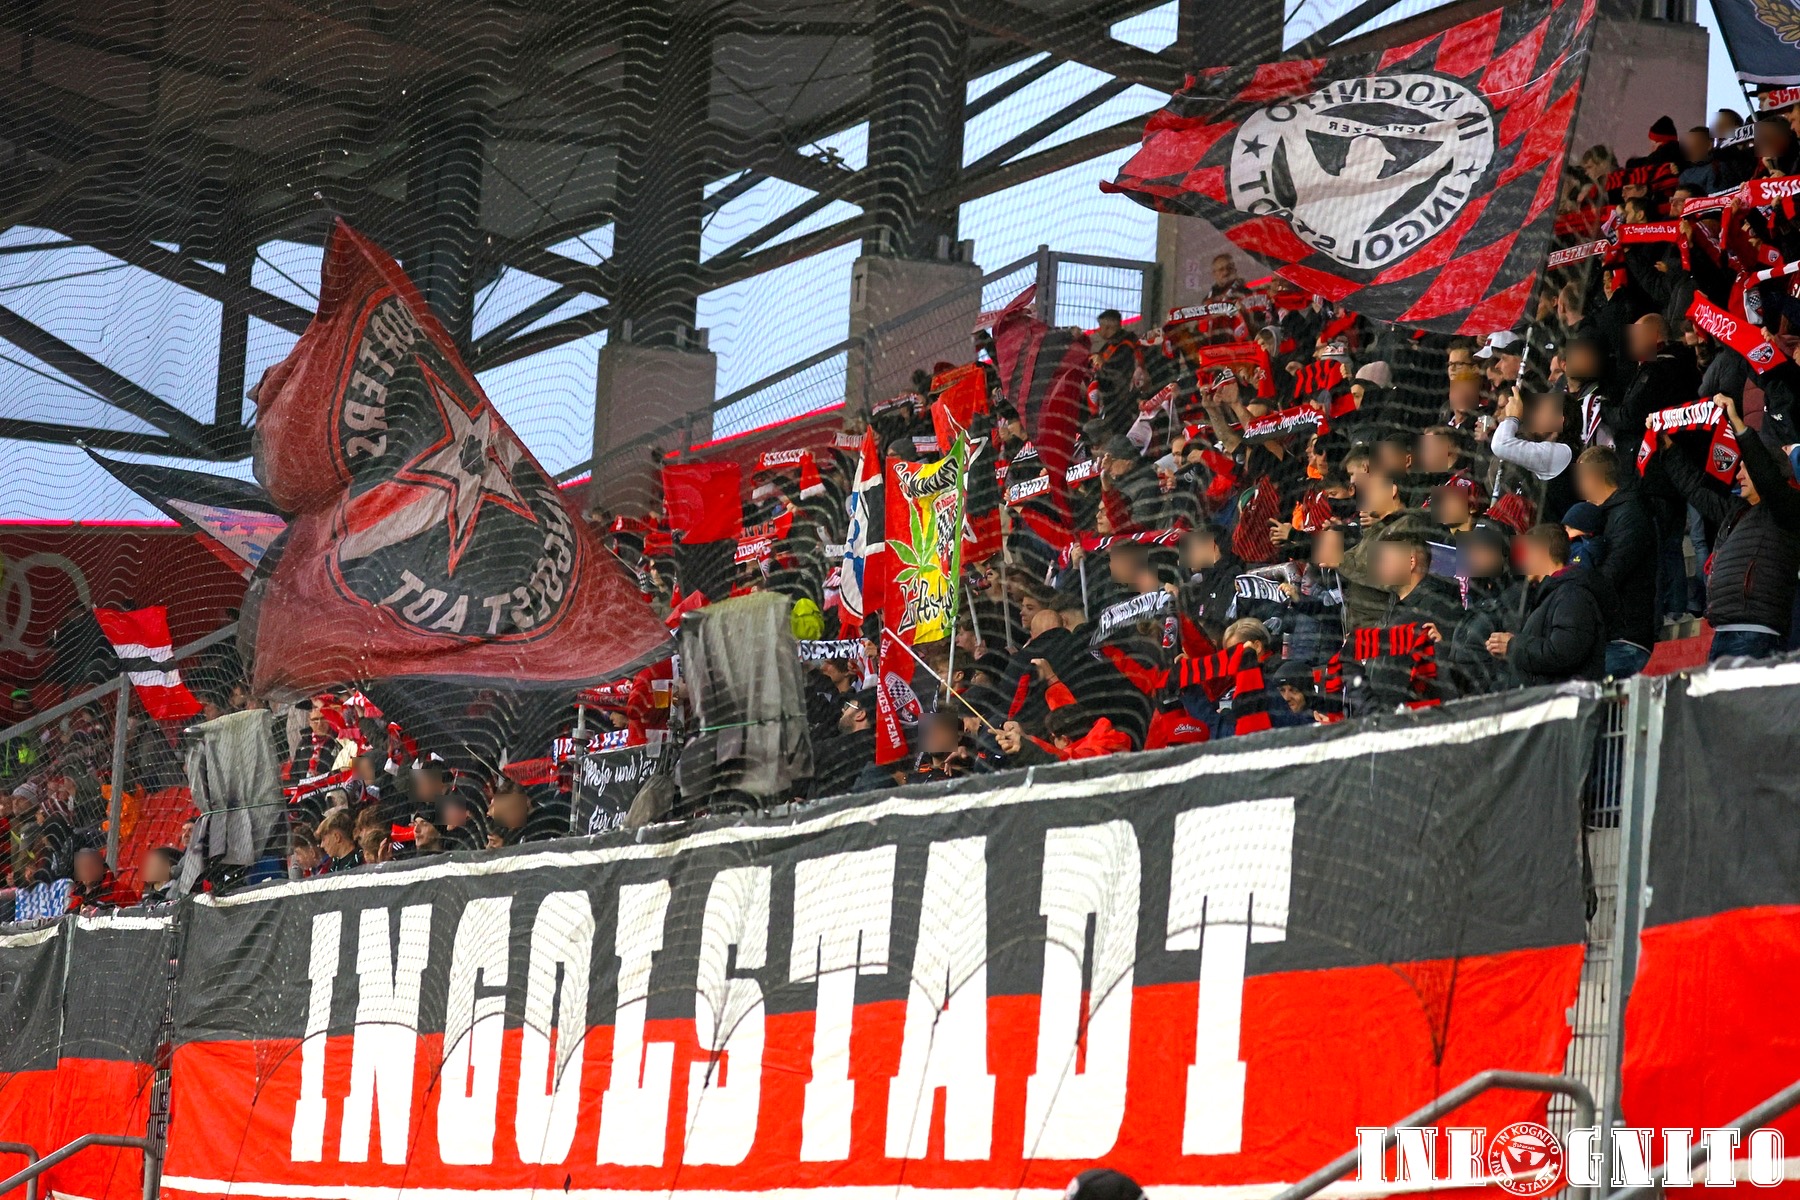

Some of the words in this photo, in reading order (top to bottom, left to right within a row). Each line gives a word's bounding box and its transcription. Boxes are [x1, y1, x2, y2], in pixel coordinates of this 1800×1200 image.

[1662, 400, 1715, 430] INGOLSTADT
[884, 714, 902, 749] TEAM
[615, 755, 637, 783] und
[290, 796, 1295, 1166] INGOLSTADT
